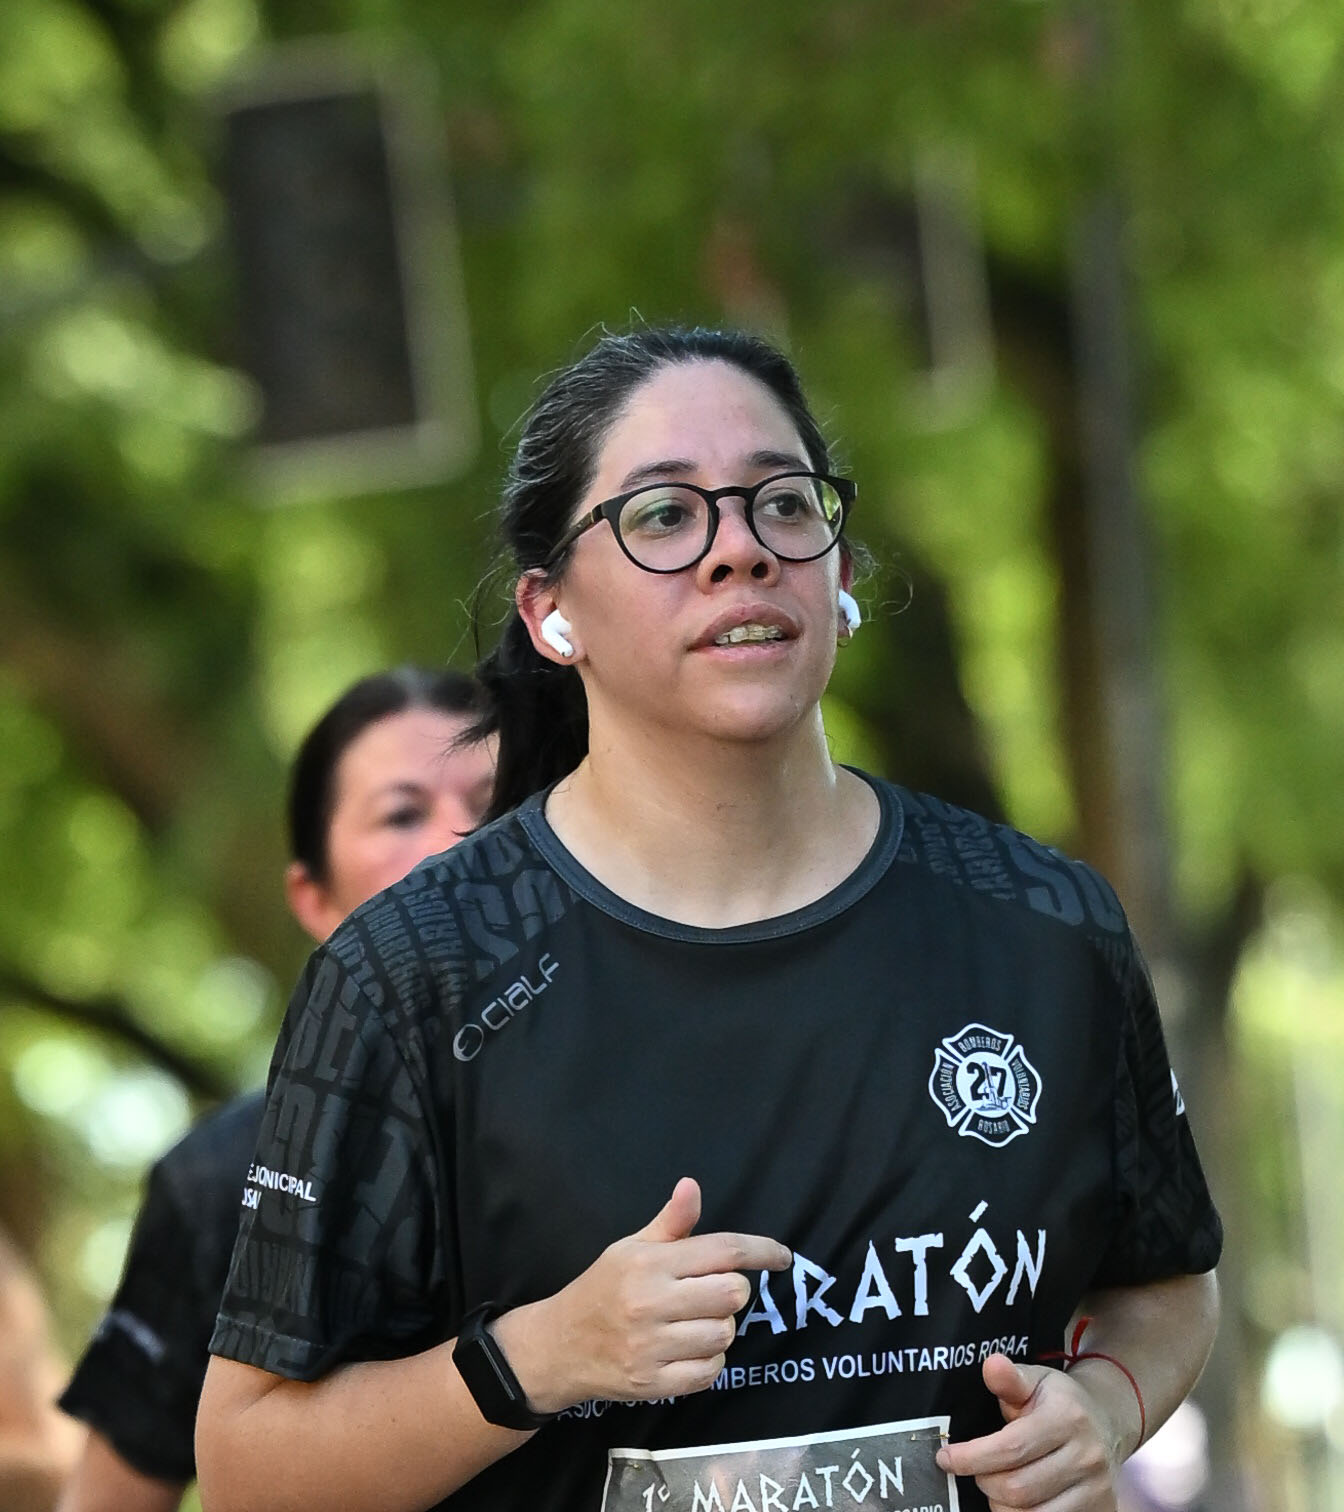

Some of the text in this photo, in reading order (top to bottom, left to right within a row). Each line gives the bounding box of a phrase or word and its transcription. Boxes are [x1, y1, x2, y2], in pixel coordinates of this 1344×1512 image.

[966, 1061, 1007, 1101] 27
[737, 1200, 1046, 1337] ARATÓN
[710, 1358, 815, 1391] MBEROS
[822, 1343, 976, 1380] VOLUNTARIOS
